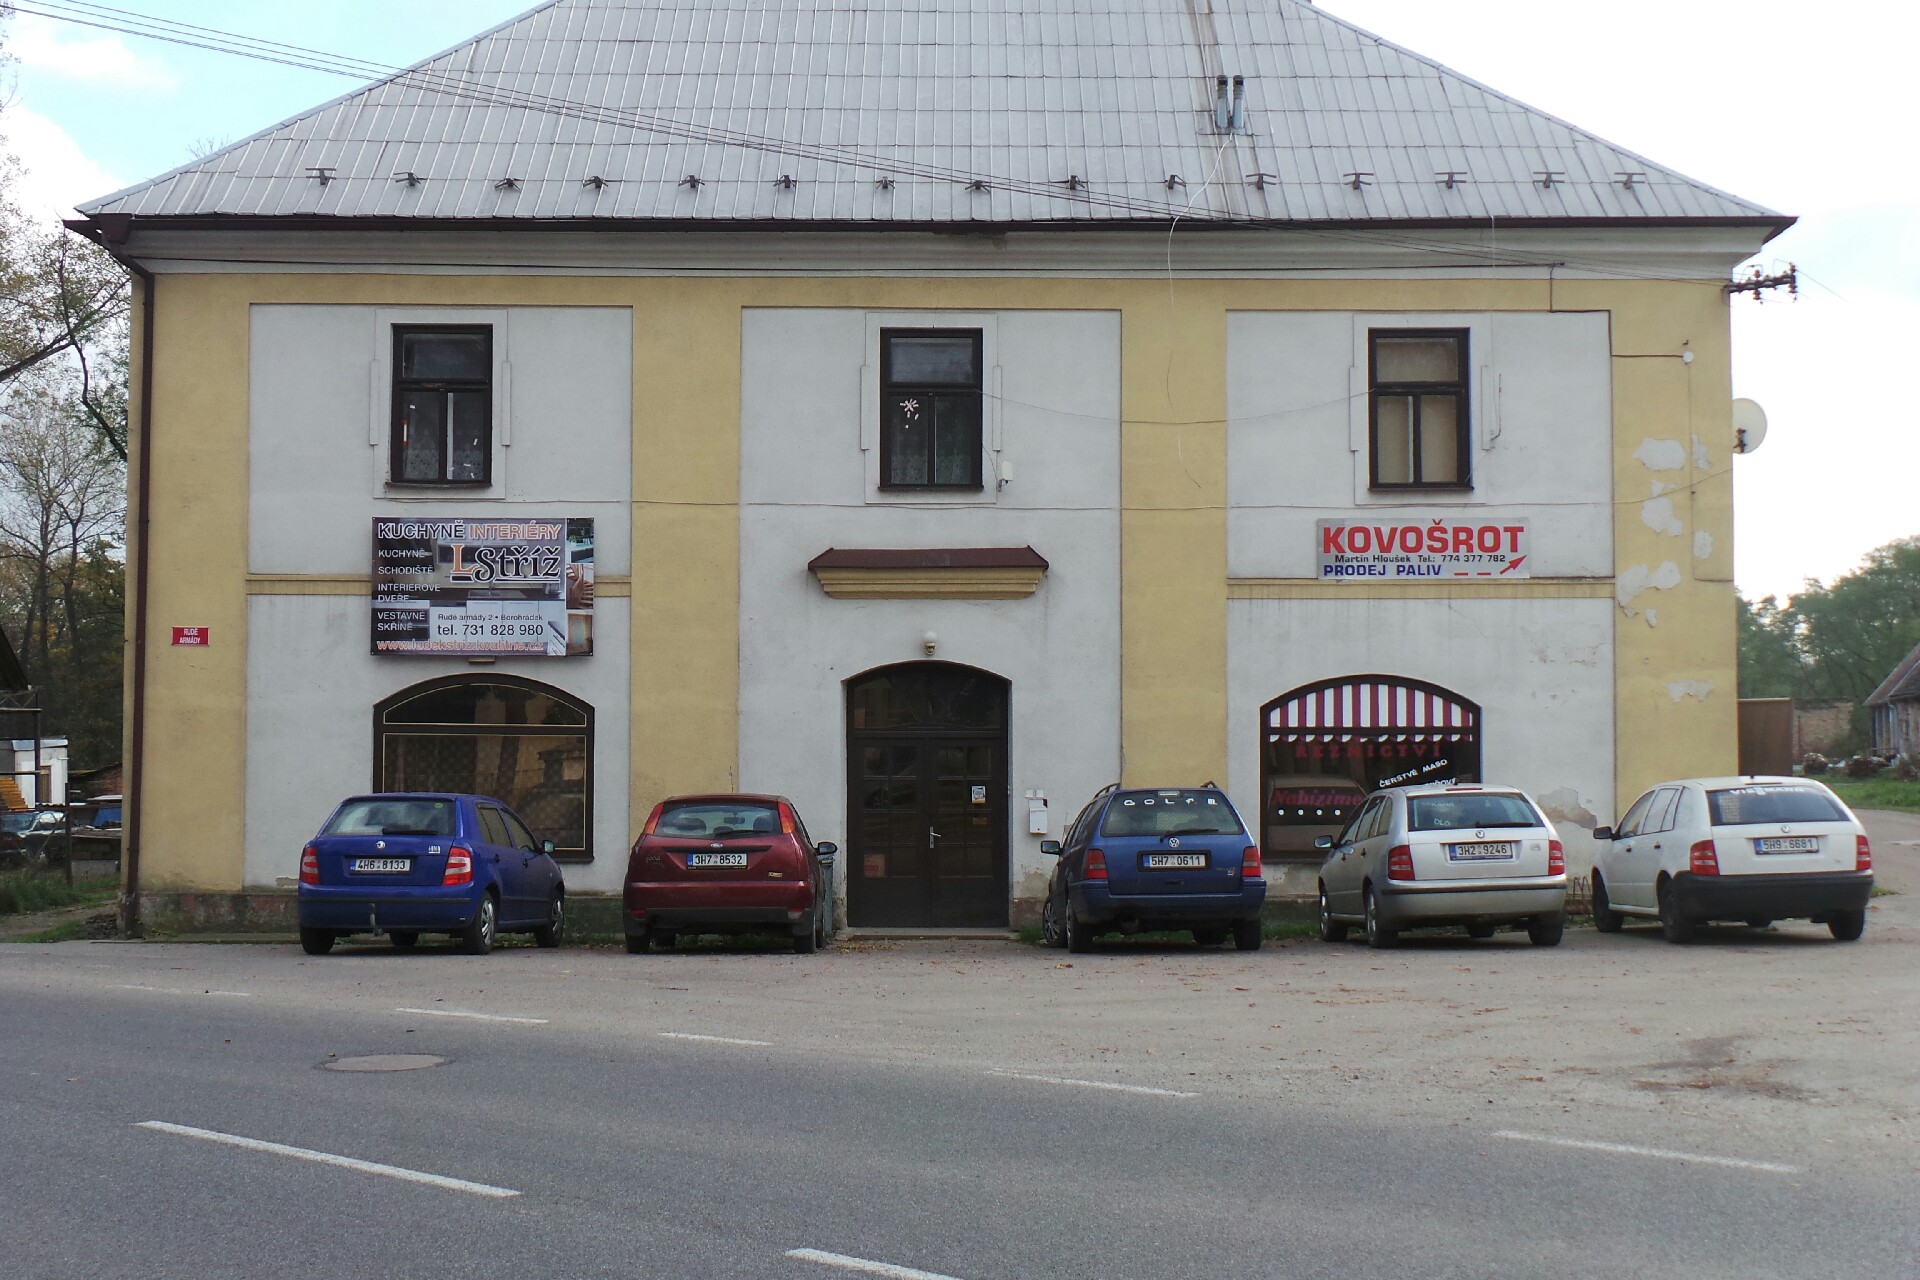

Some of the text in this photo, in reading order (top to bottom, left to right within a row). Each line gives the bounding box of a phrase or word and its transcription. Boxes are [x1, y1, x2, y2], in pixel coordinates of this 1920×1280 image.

[378, 520, 562, 539] KUCHYNĚ INTERIÉRY
[1323, 518, 1525, 554] KOVOŠROT
[378, 548, 425, 558] KUCHYNĚ
[1335, 554, 1506, 563] Martin Hloušek Tel.: 774 377 782
[378, 565, 433, 575] SCHODIŠTĚ
[1323, 564, 1442, 576] PRODEJ PALIV
[437, 624, 544, 636] tel. 731 828 980
[1378, 768, 1419, 788] ČERSTVÉ
[1422, 759, 1448, 773] MASO
[1458, 844, 1507, 856] 3H2 9246
[1763, 839, 1781, 850] 5H9
[357, 860, 406, 870] 4H6 8133
[695, 854, 743, 865] 3H7 8532
[1151, 855, 1200, 866] 5H7 0611
